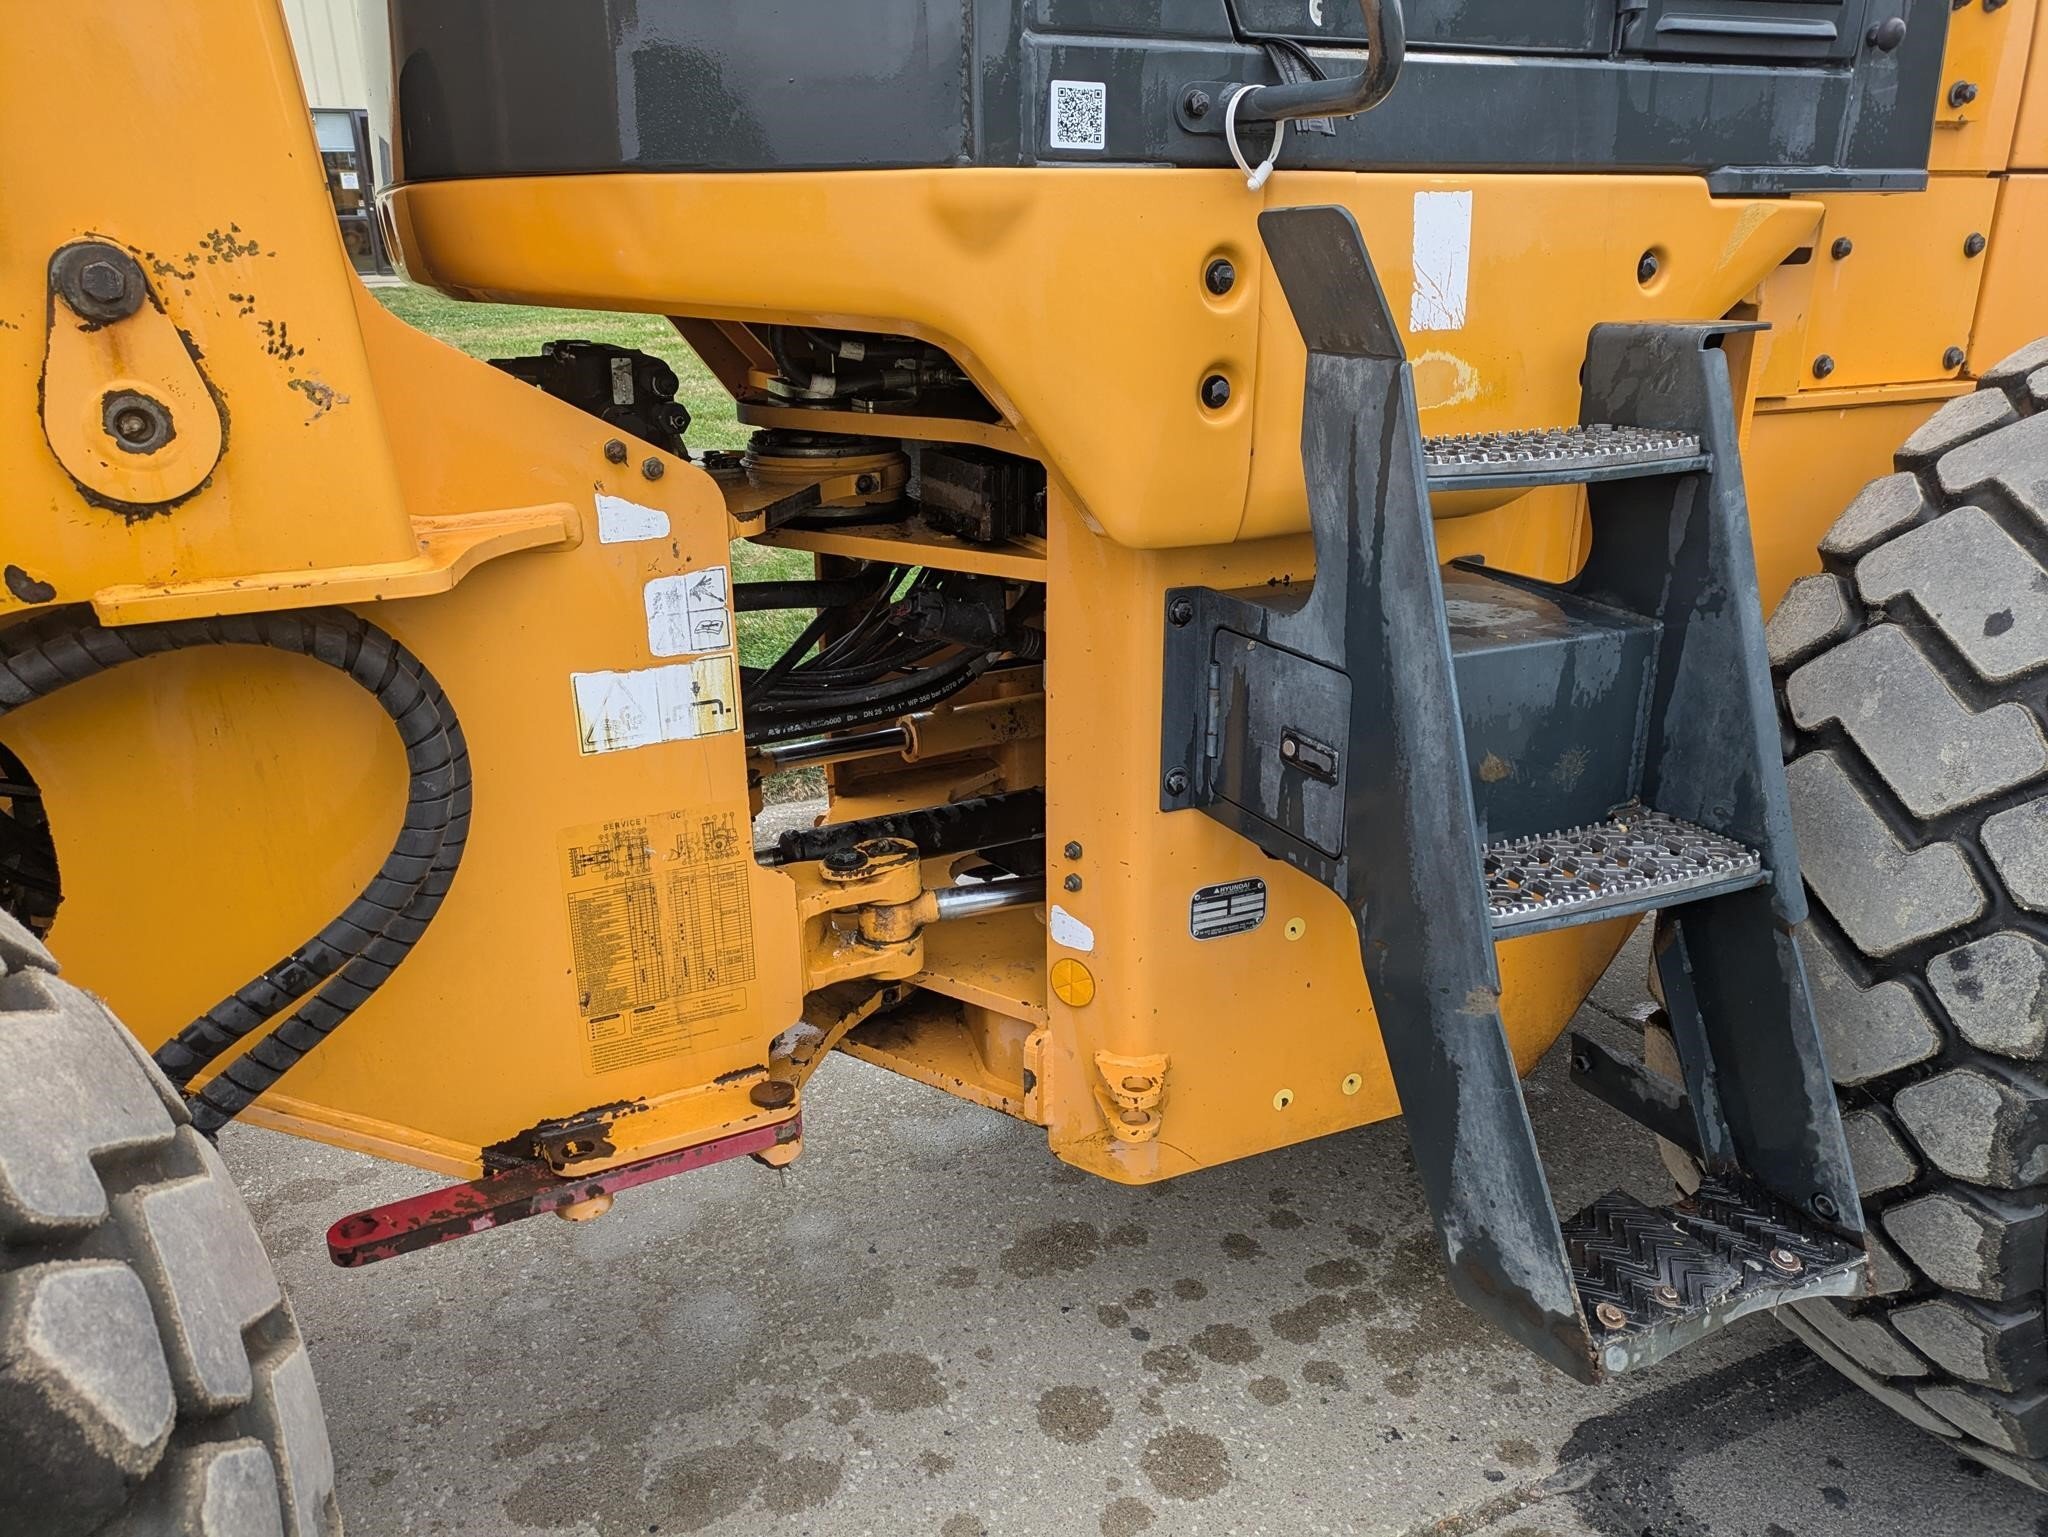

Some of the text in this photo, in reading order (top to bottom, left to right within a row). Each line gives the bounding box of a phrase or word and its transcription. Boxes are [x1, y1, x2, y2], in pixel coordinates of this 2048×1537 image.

[863, 710, 873, 718] DN
[907, 698, 918, 706] WP
[919, 694, 930, 703] 350
[931, 690, 941, 698] bar
[603, 818, 641, 831] SERVICE
[1220, 882, 1250, 892] HYUNDAI
